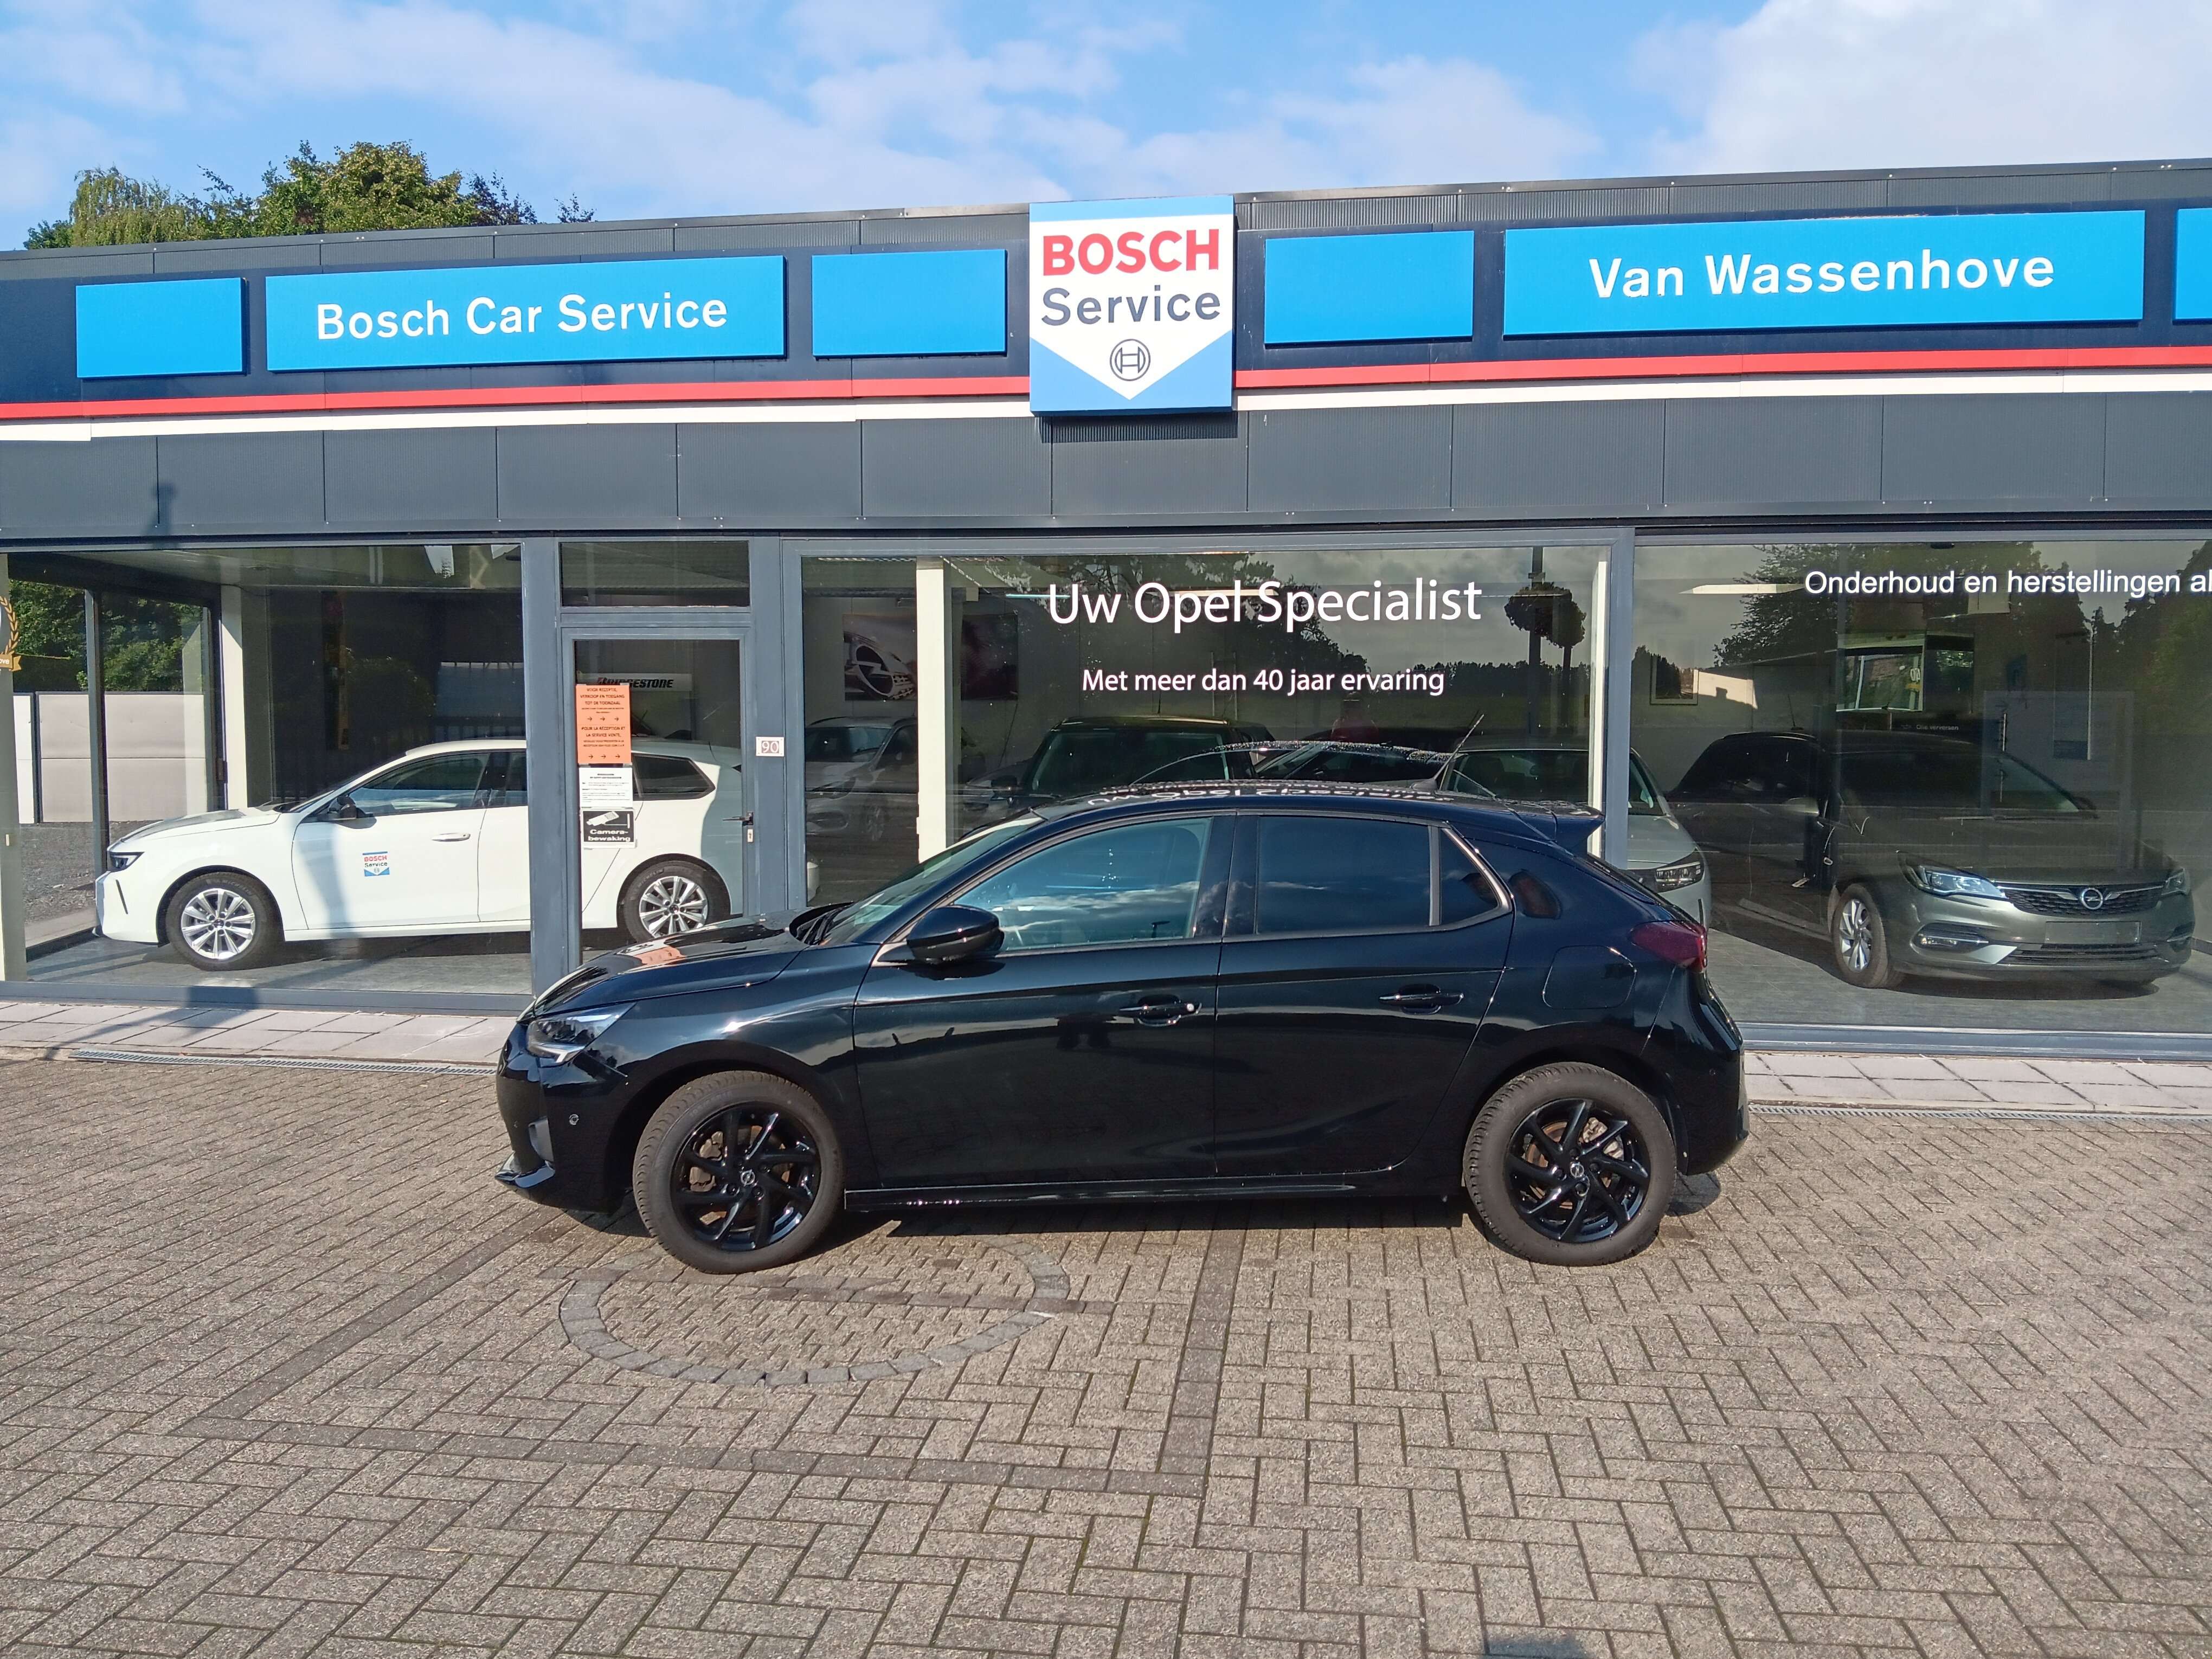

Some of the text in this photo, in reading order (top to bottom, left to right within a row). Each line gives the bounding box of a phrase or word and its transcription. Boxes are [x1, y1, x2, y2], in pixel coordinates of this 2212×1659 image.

[1043, 229, 1219, 276] BOSCH
[1589, 249, 2054, 298] Van Wassenhove
[317, 292, 727, 340] Bosch Car Service
[1041, 284, 1220, 326] Service
[1049, 577, 1482, 633] Uw Opel Specialist
[1805, 570, 1954, 594] Onderhoud
[1964, 576, 1997, 593] en
[2008, 569, 2180, 599] herstellingen
[1082, 668, 1444, 696] Met meer dan 40 jaar ervaring
[762, 741, 779, 753] 90
